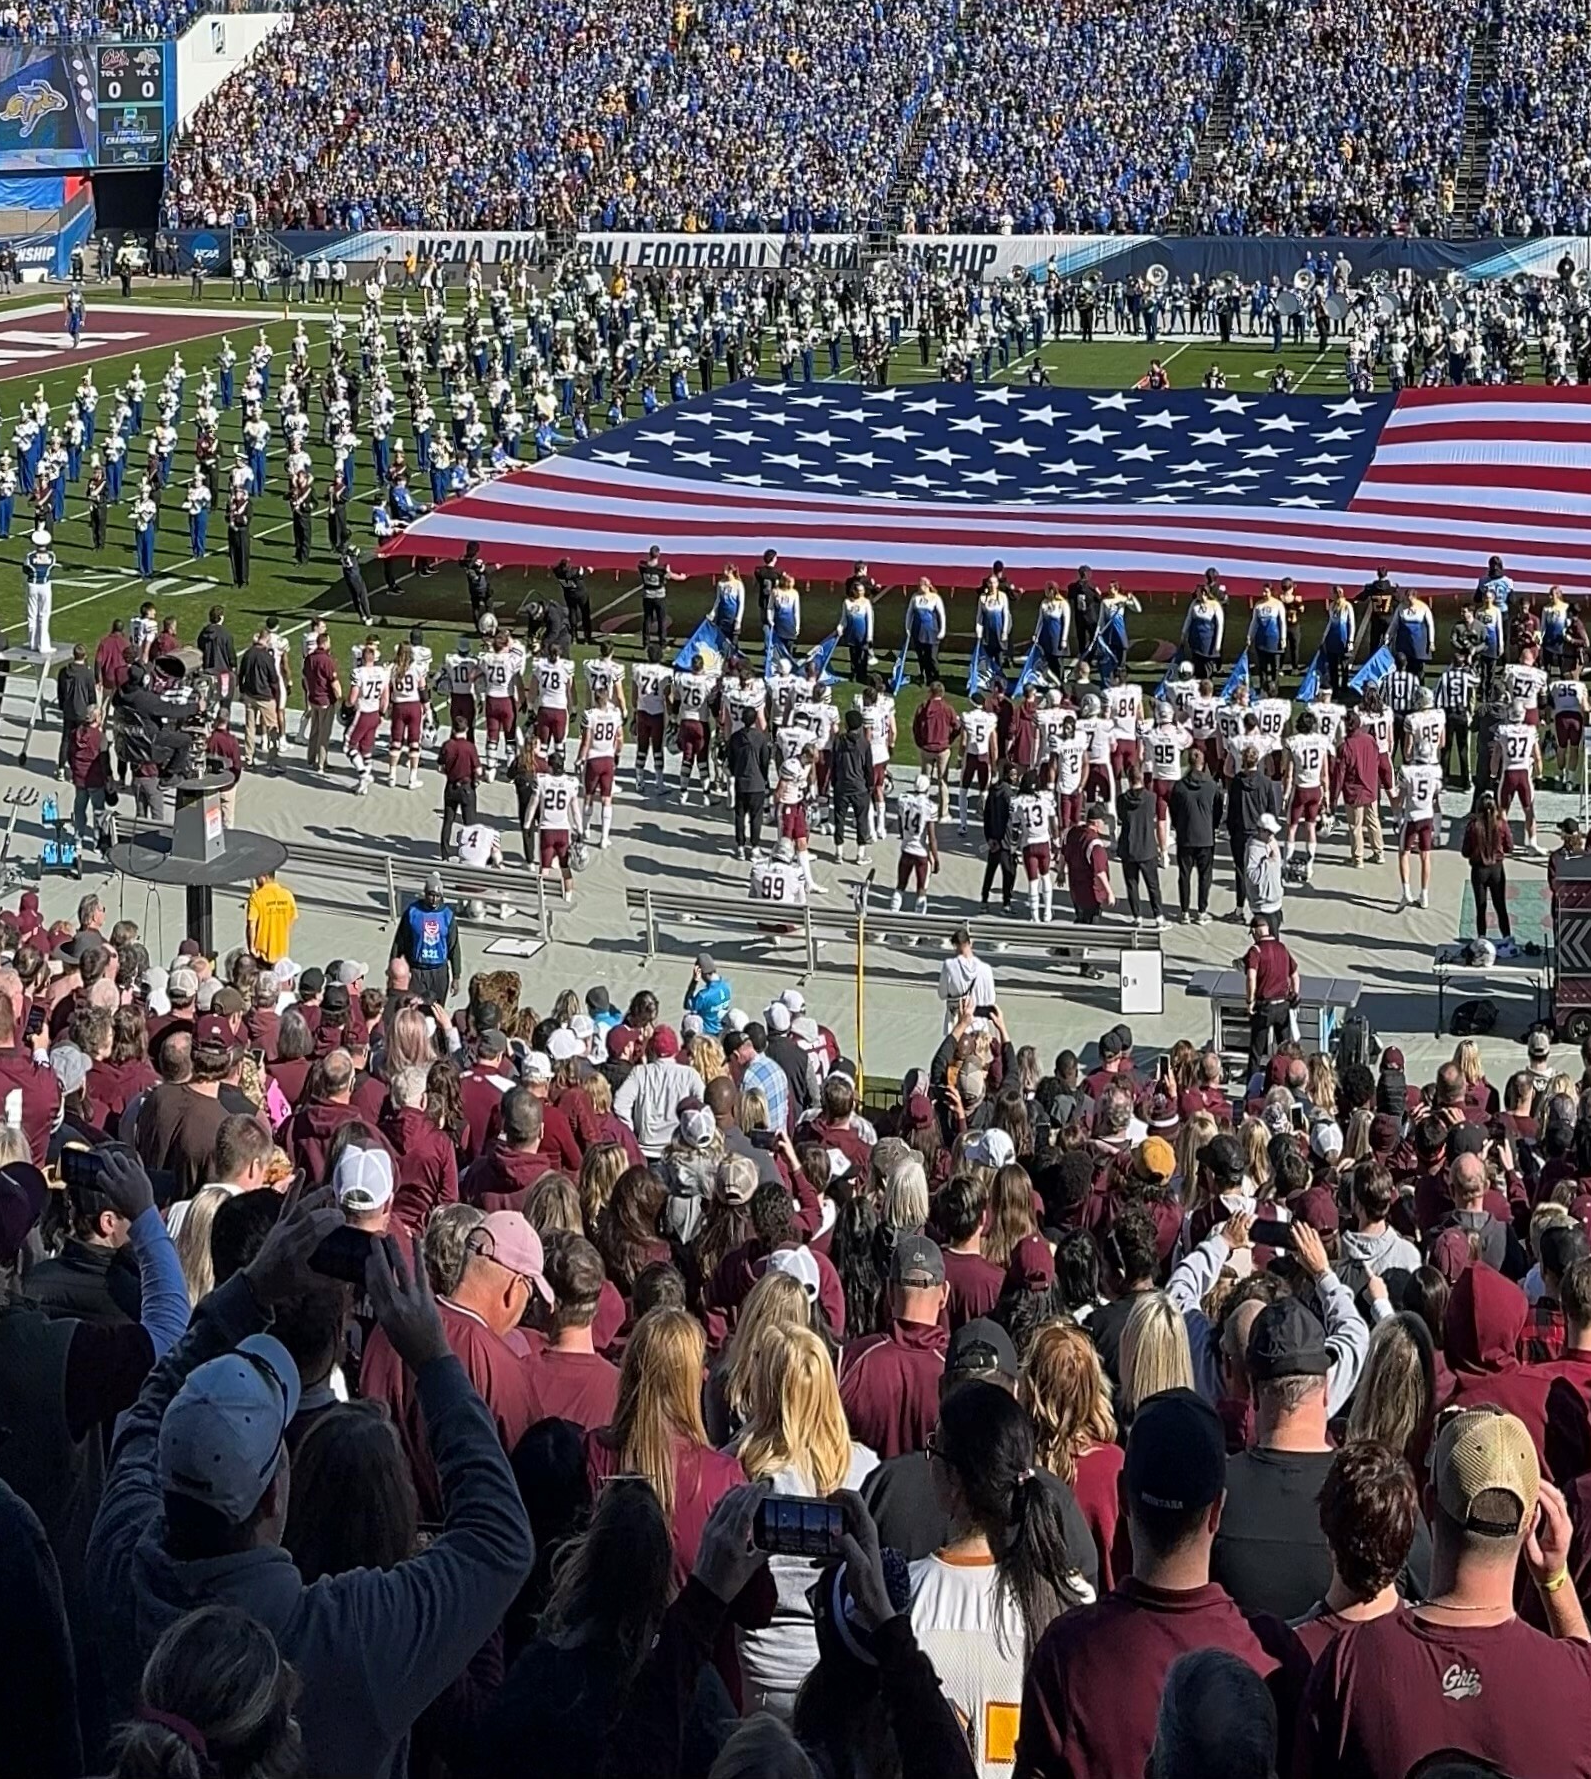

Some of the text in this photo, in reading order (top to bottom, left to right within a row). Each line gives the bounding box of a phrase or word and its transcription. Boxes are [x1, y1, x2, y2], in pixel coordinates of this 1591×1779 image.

[108, 81, 154, 99] 0 0
[417, 240, 484, 263] NCAA
[637, 242, 766, 268] FOOTBALL
[454, 667, 468, 682] 10
[487, 667, 506, 684] 79
[541, 672, 560, 689] 78
[365, 682, 383, 699] 75
[640, 678, 659, 695] 74
[1448, 682, 1460, 696] S
[1513, 680, 1531, 697] 57
[1558, 682, 1576, 696] 35
[682, 689, 701, 707] 76
[778, 689, 787, 704] 6
[1118, 700, 1135, 717] 84
[1194, 710, 1214, 729] 54
[1263, 714, 1282, 733] 98
[1321, 715, 1330, 733] 8
[595, 724, 614, 740] 88
[975, 725, 985, 742] 5
[1154, 744, 1174, 764] 95
[1508, 737, 1527, 758] 37
[1070, 755, 1078, 774] 2
[1302, 749, 1319, 767] 12
[1417, 777, 1427, 799] 5
[554, 789, 577, 810] 26
[904, 811, 920, 833] 14
[1021, 806, 1040, 827] 13
[468, 831, 479, 848] 4
[761, 876, 785, 901] 99
[5, 1088, 23, 1129] 1
[1141, 1492, 1183, 1510] MONTANA
[1443, 1664, 1482, 1693] Griz
